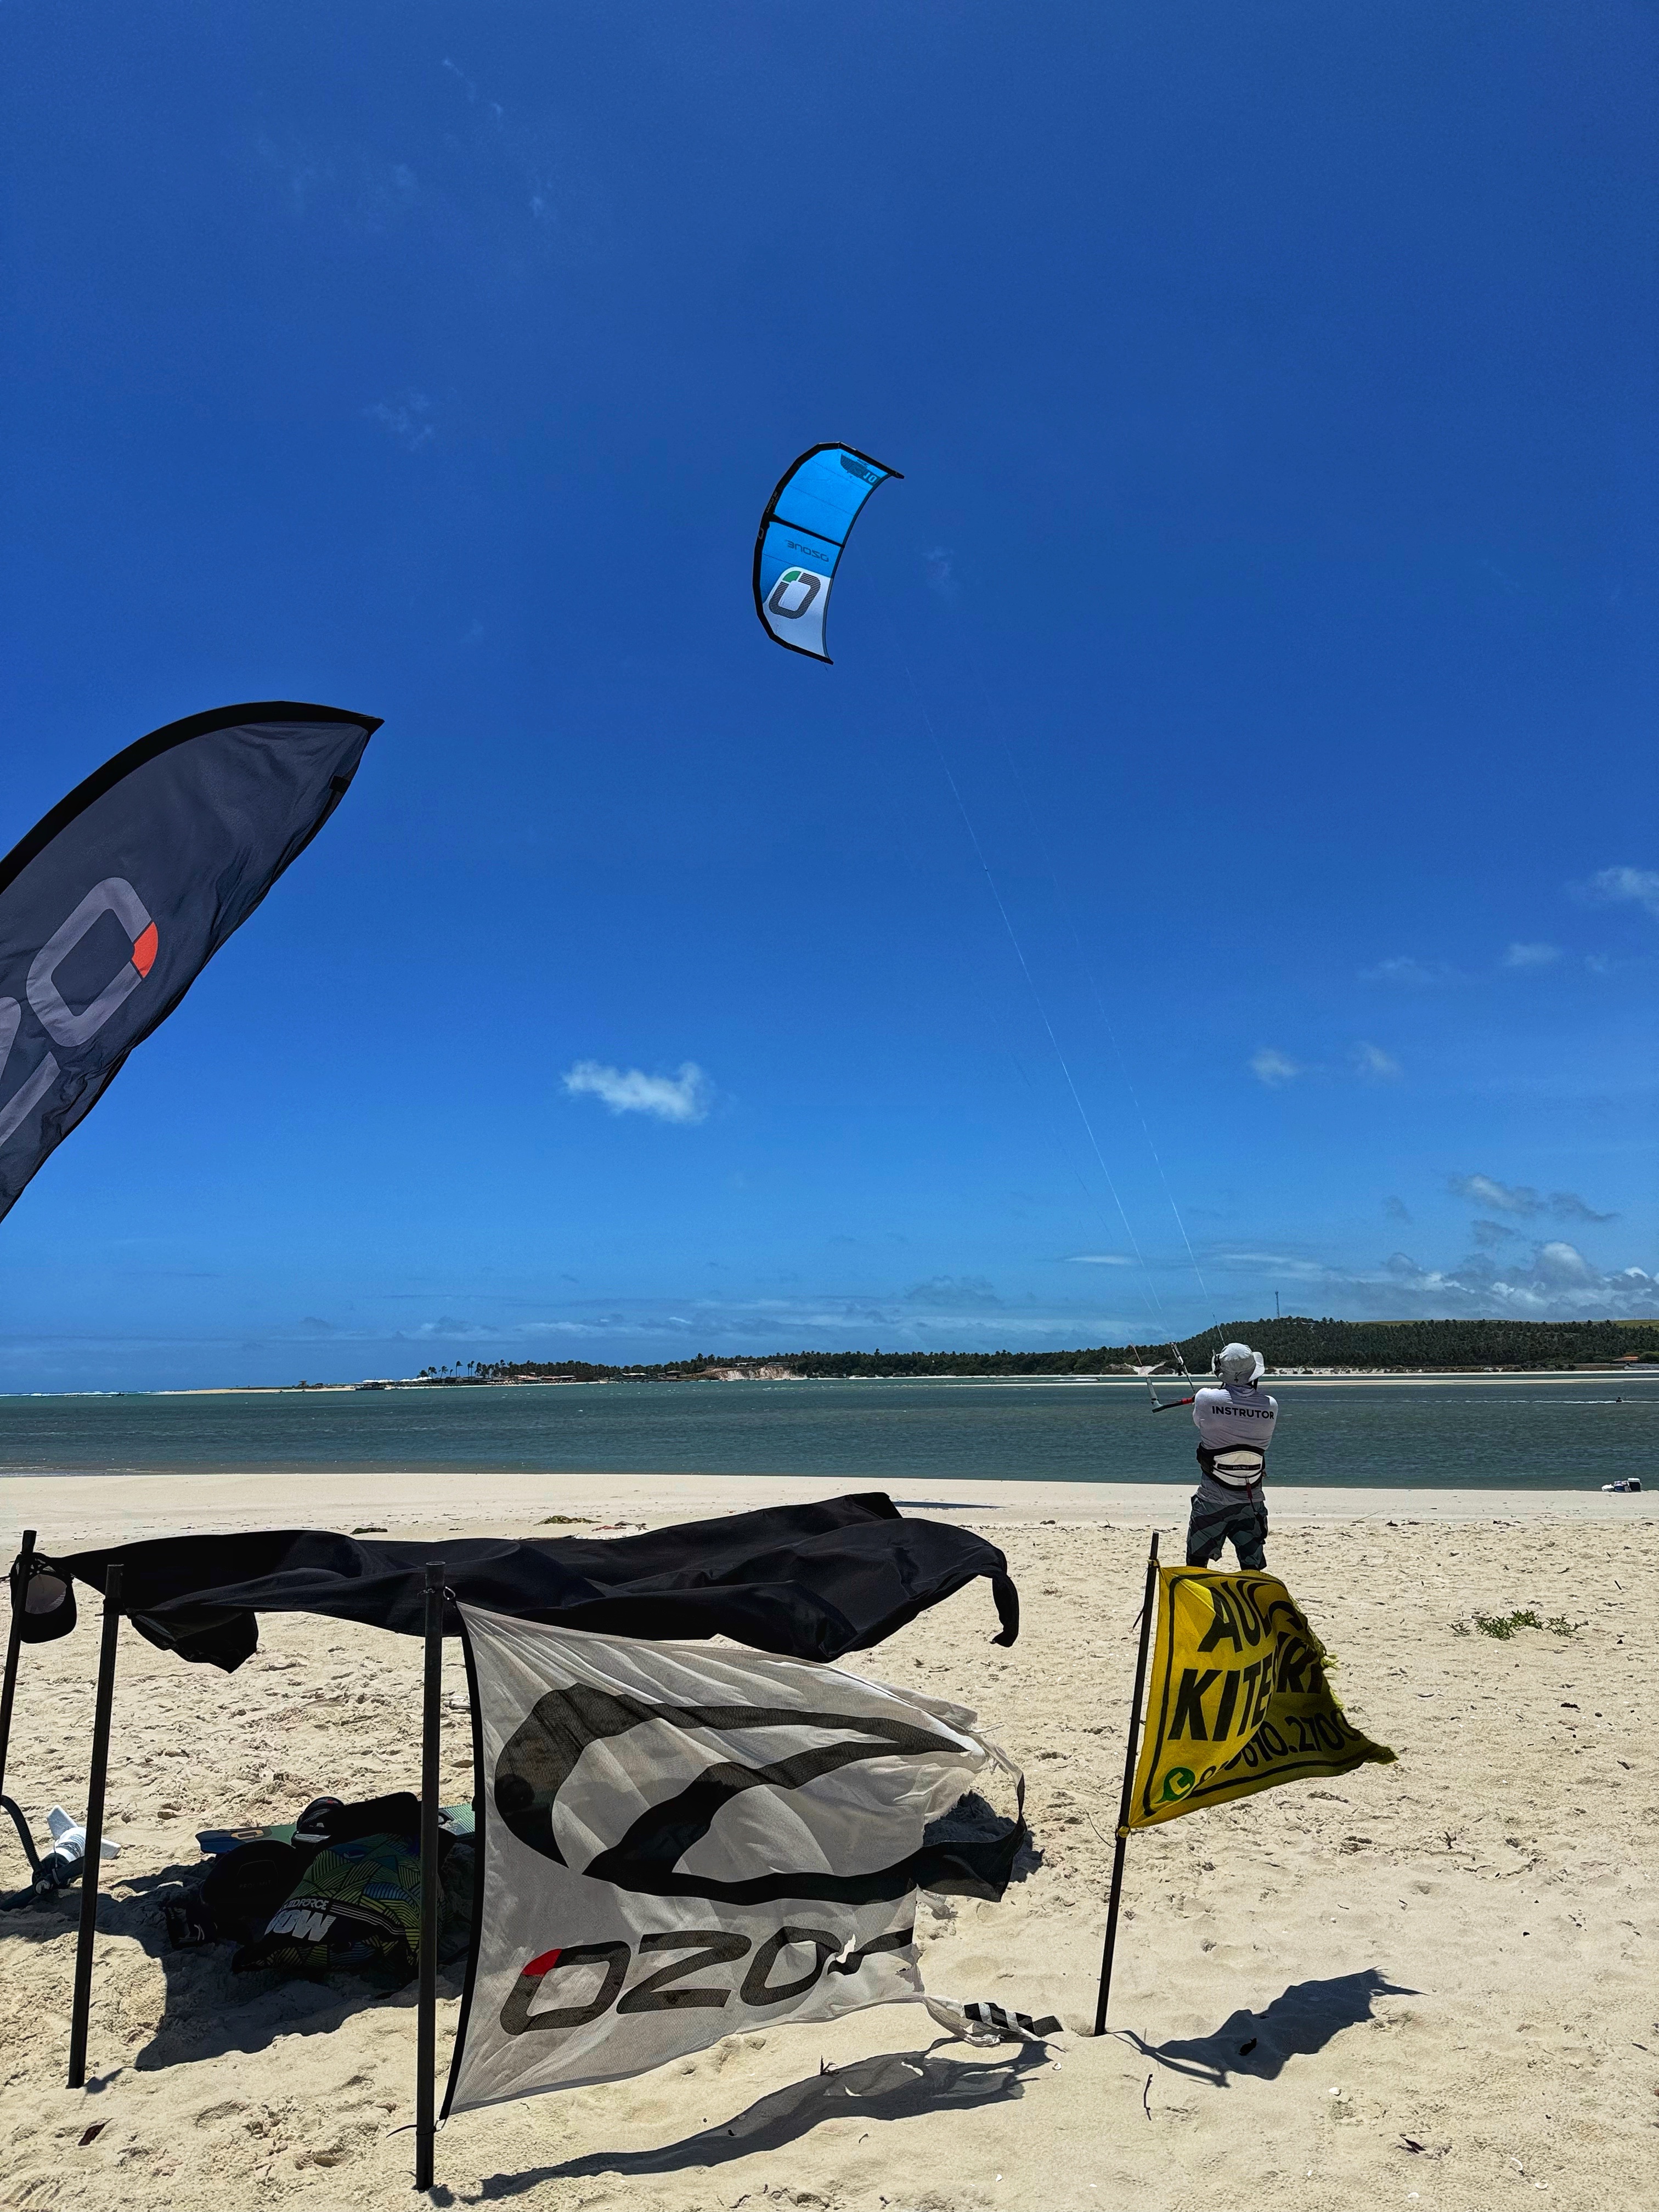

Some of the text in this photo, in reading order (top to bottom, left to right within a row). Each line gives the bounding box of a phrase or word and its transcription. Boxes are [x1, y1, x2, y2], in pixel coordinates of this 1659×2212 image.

[1212, 1405, 1274, 1420] INSTRUTOR
[239, 1880, 272, 1890] PROMIT
[264, 1909, 336, 1942] OW
